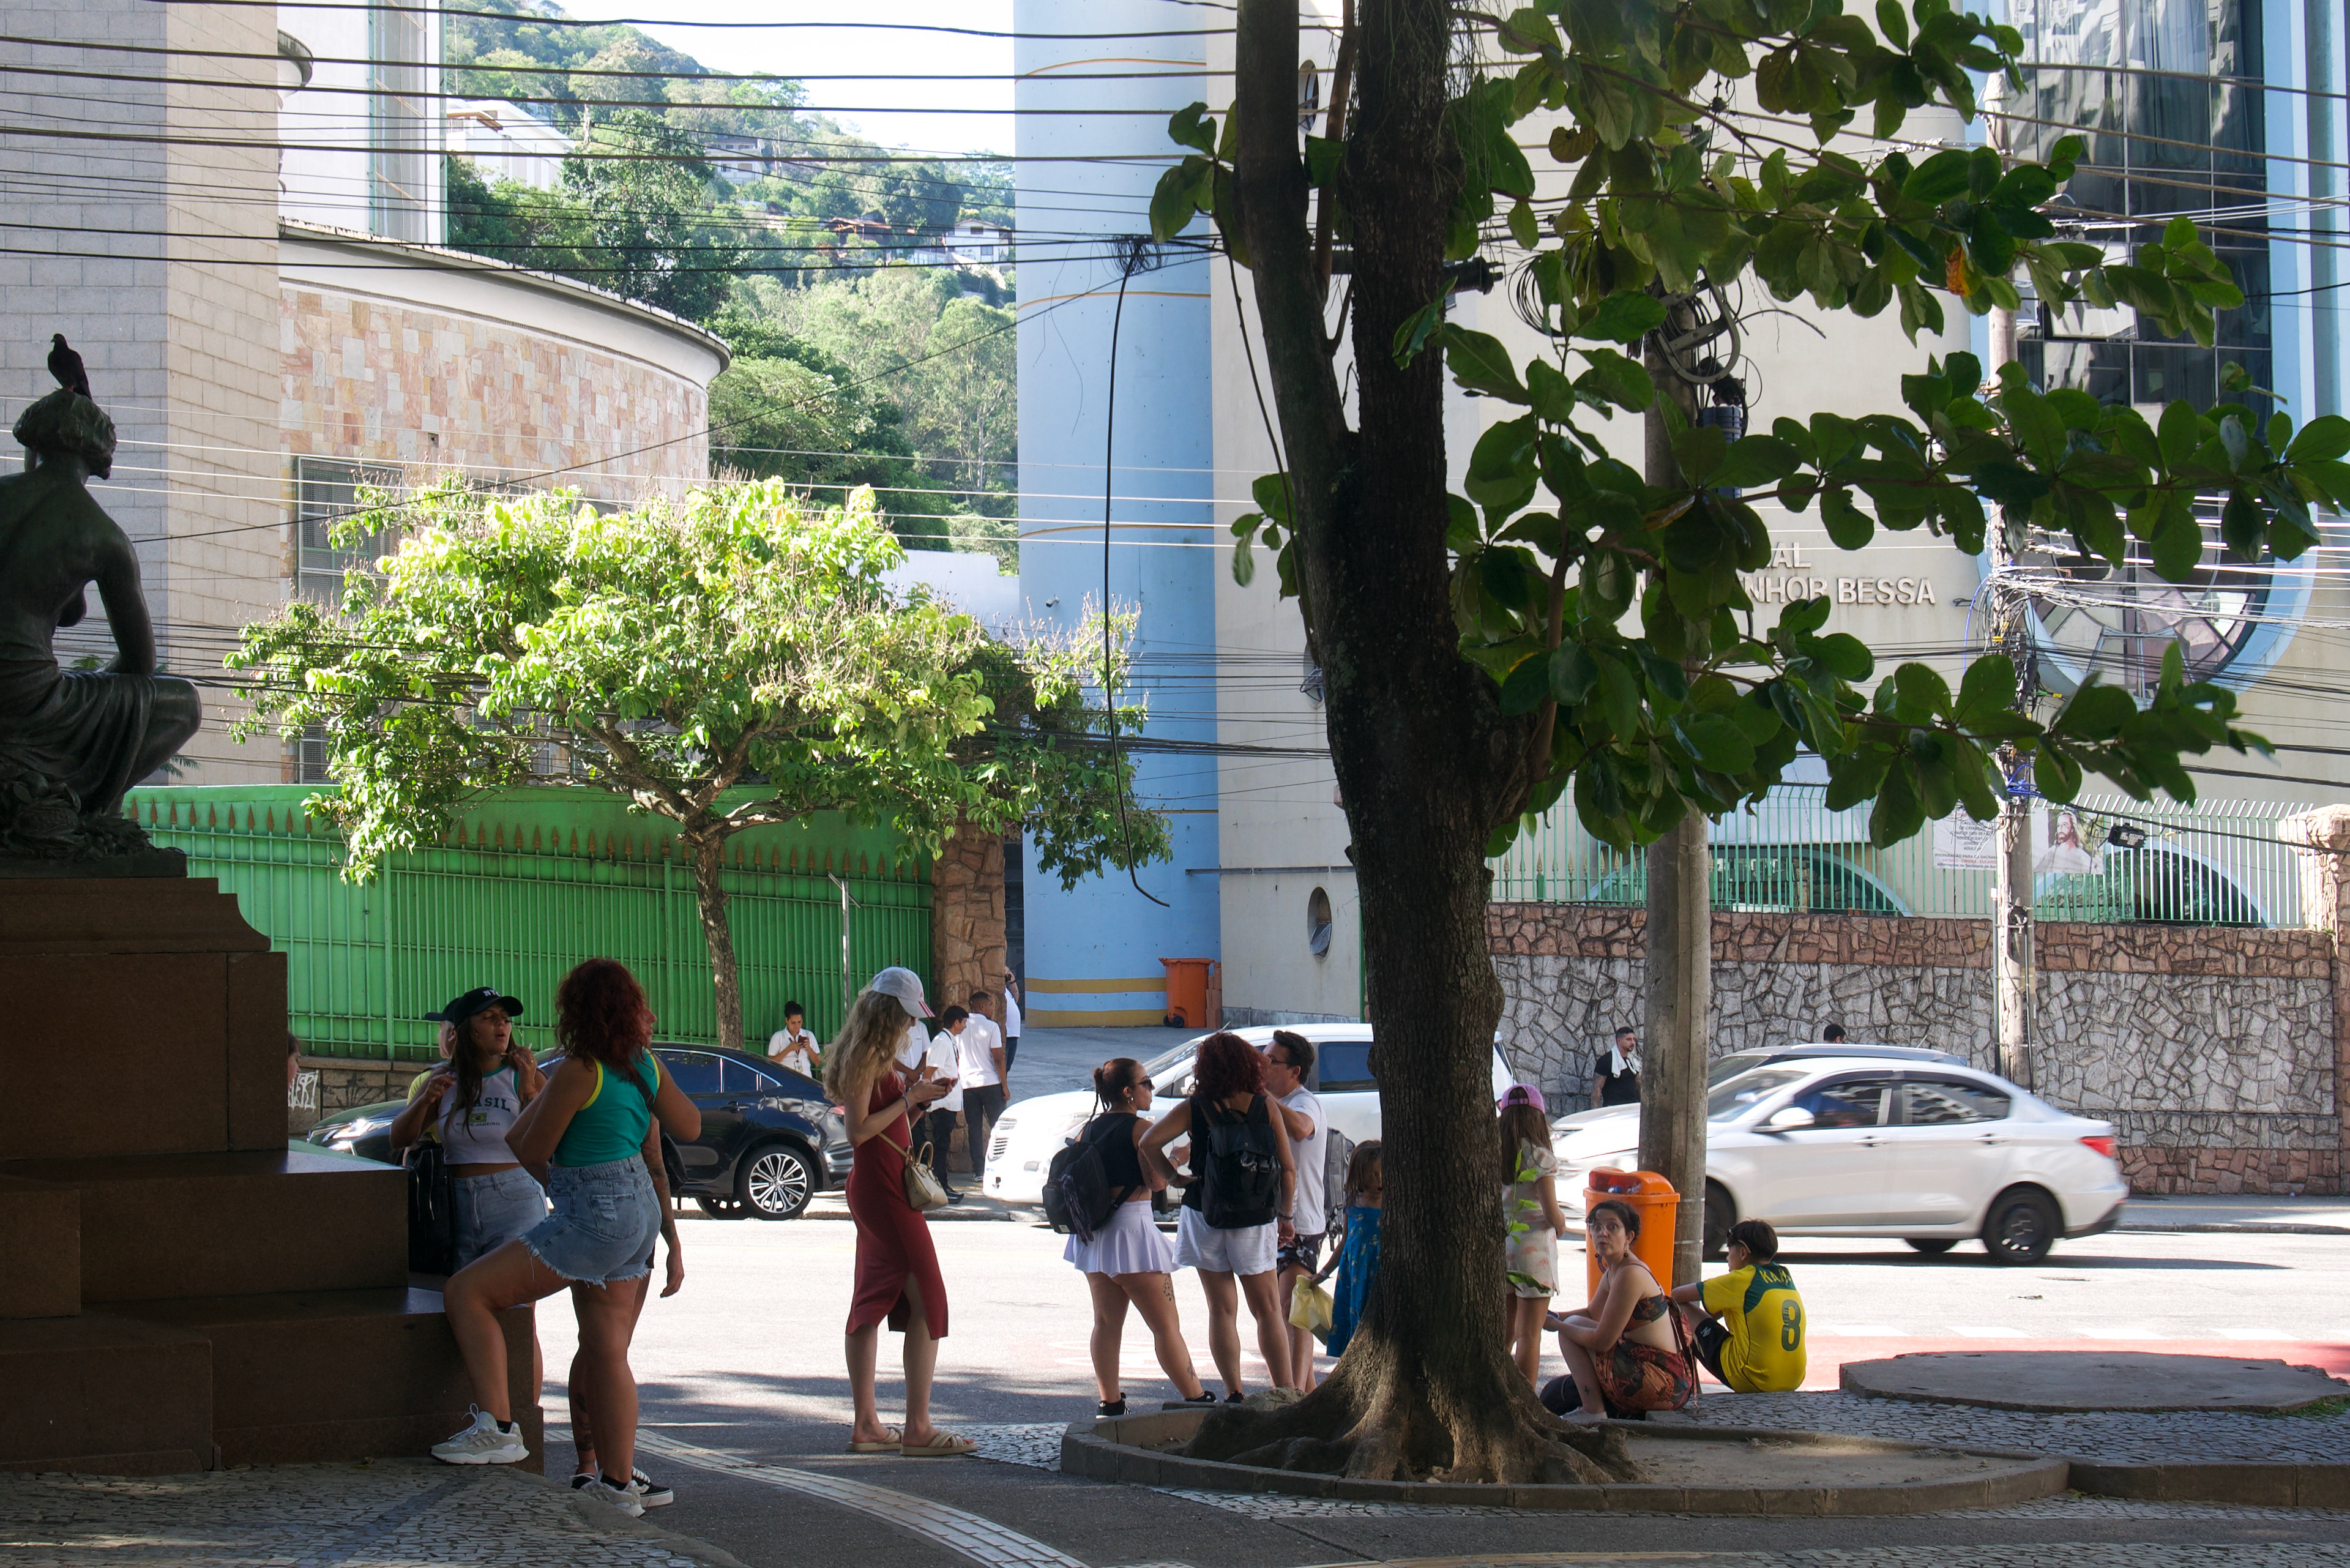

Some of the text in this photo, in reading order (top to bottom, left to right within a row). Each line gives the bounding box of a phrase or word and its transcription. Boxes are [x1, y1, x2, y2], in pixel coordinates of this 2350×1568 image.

[1767, 542, 1811, 569] AL
[1742, 575, 1936, 605] NHOR BESSA
[1781, 1299, 1801, 1351] 8
